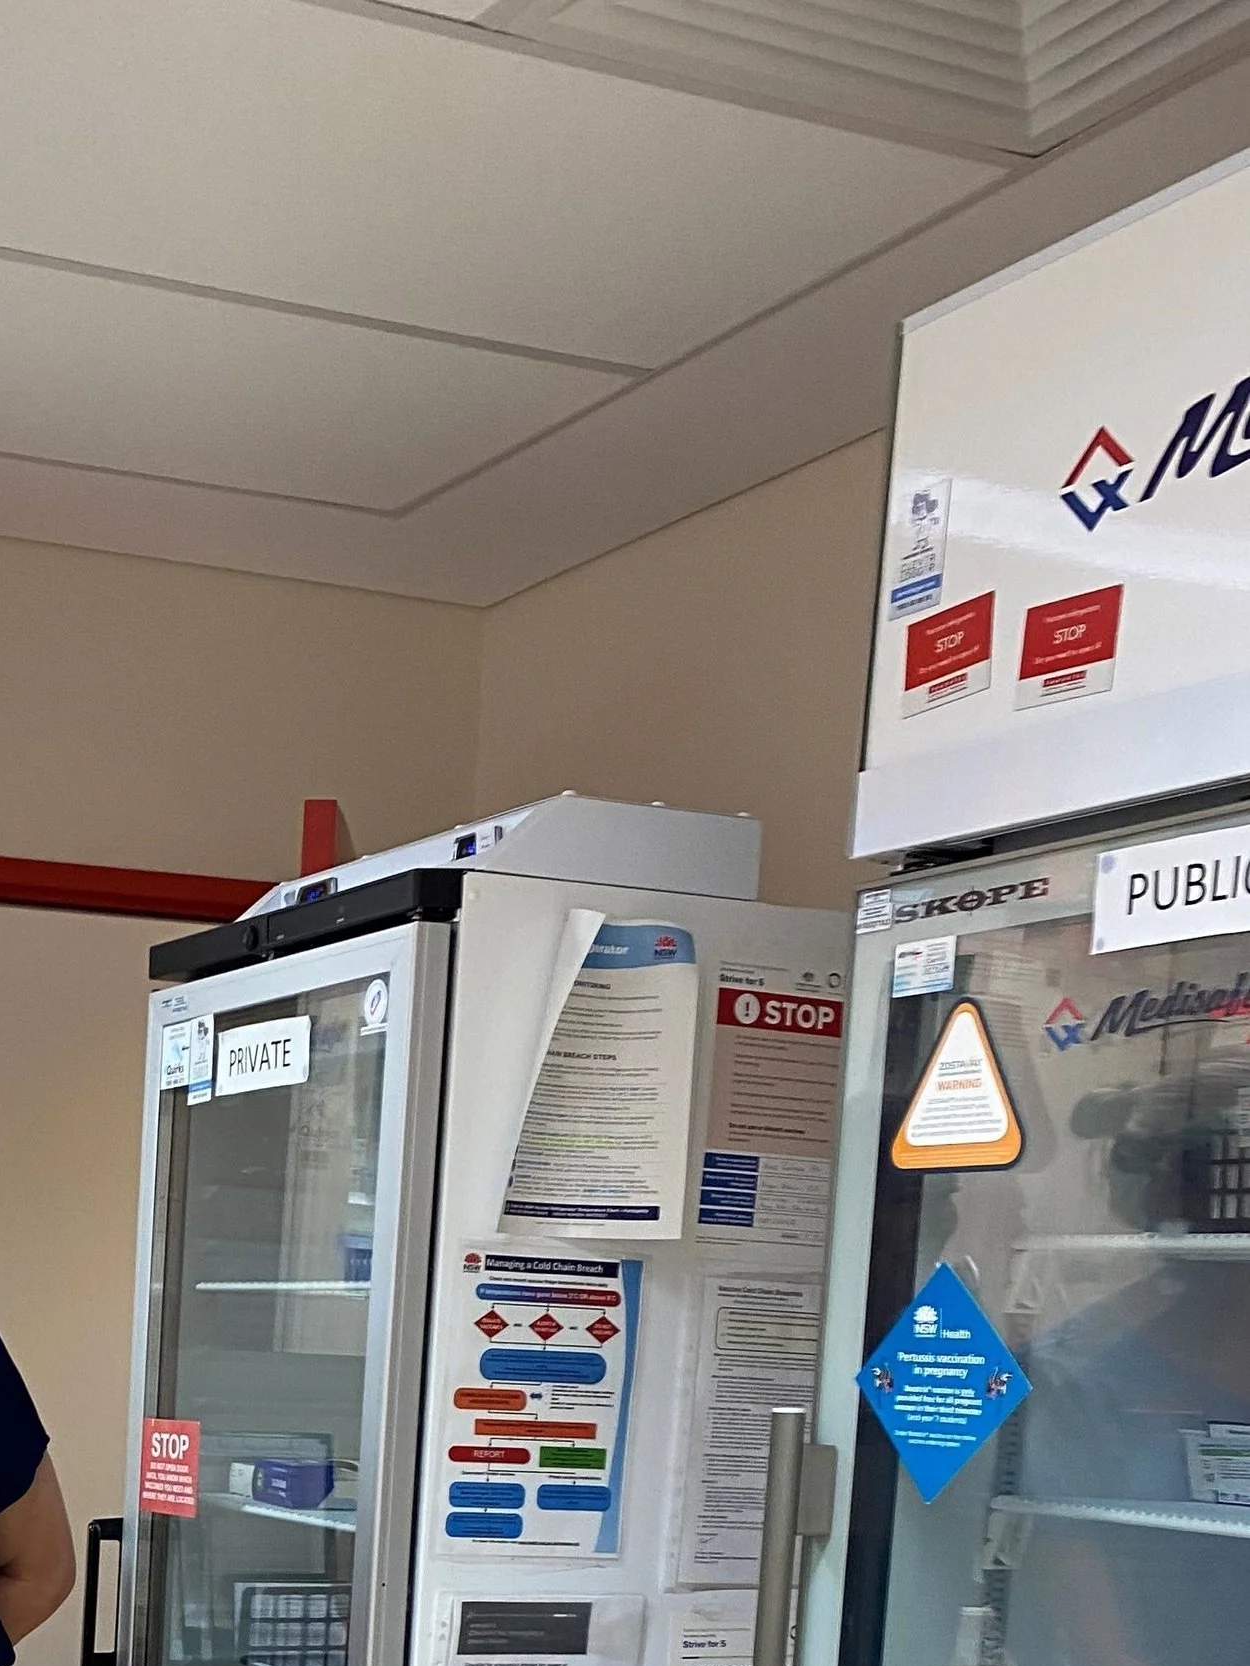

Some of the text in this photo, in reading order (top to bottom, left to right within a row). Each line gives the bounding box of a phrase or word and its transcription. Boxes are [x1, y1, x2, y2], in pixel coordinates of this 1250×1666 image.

[935, 630, 965, 653] STOP
[1053, 624, 1087, 645] STOP
[1128, 856, 1250, 915] PUBLI
[896, 877, 1050, 924] SKOPE
[764, 1000, 835, 1030] STOP
[228, 1038, 292, 1077] PRIVATE
[937, 1078, 982, 1091] WARNING
[486, 1258, 525, 1271] Managing
[533, 1261, 552, 1270] Cold
[553, 1262, 576, 1272] Chain
[577, 1263, 604, 1273] Breach
[913, 1323, 971, 1339] NSW Health
[897, 1352, 985, 1365] Pertussis vaccination
[913, 1365, 968, 1379] in pregnancy
[151, 1432, 189, 1460] STOP
[473, 1450, 506, 1459] REPORT
[683, 1640, 727, 1648] Strive for 5
